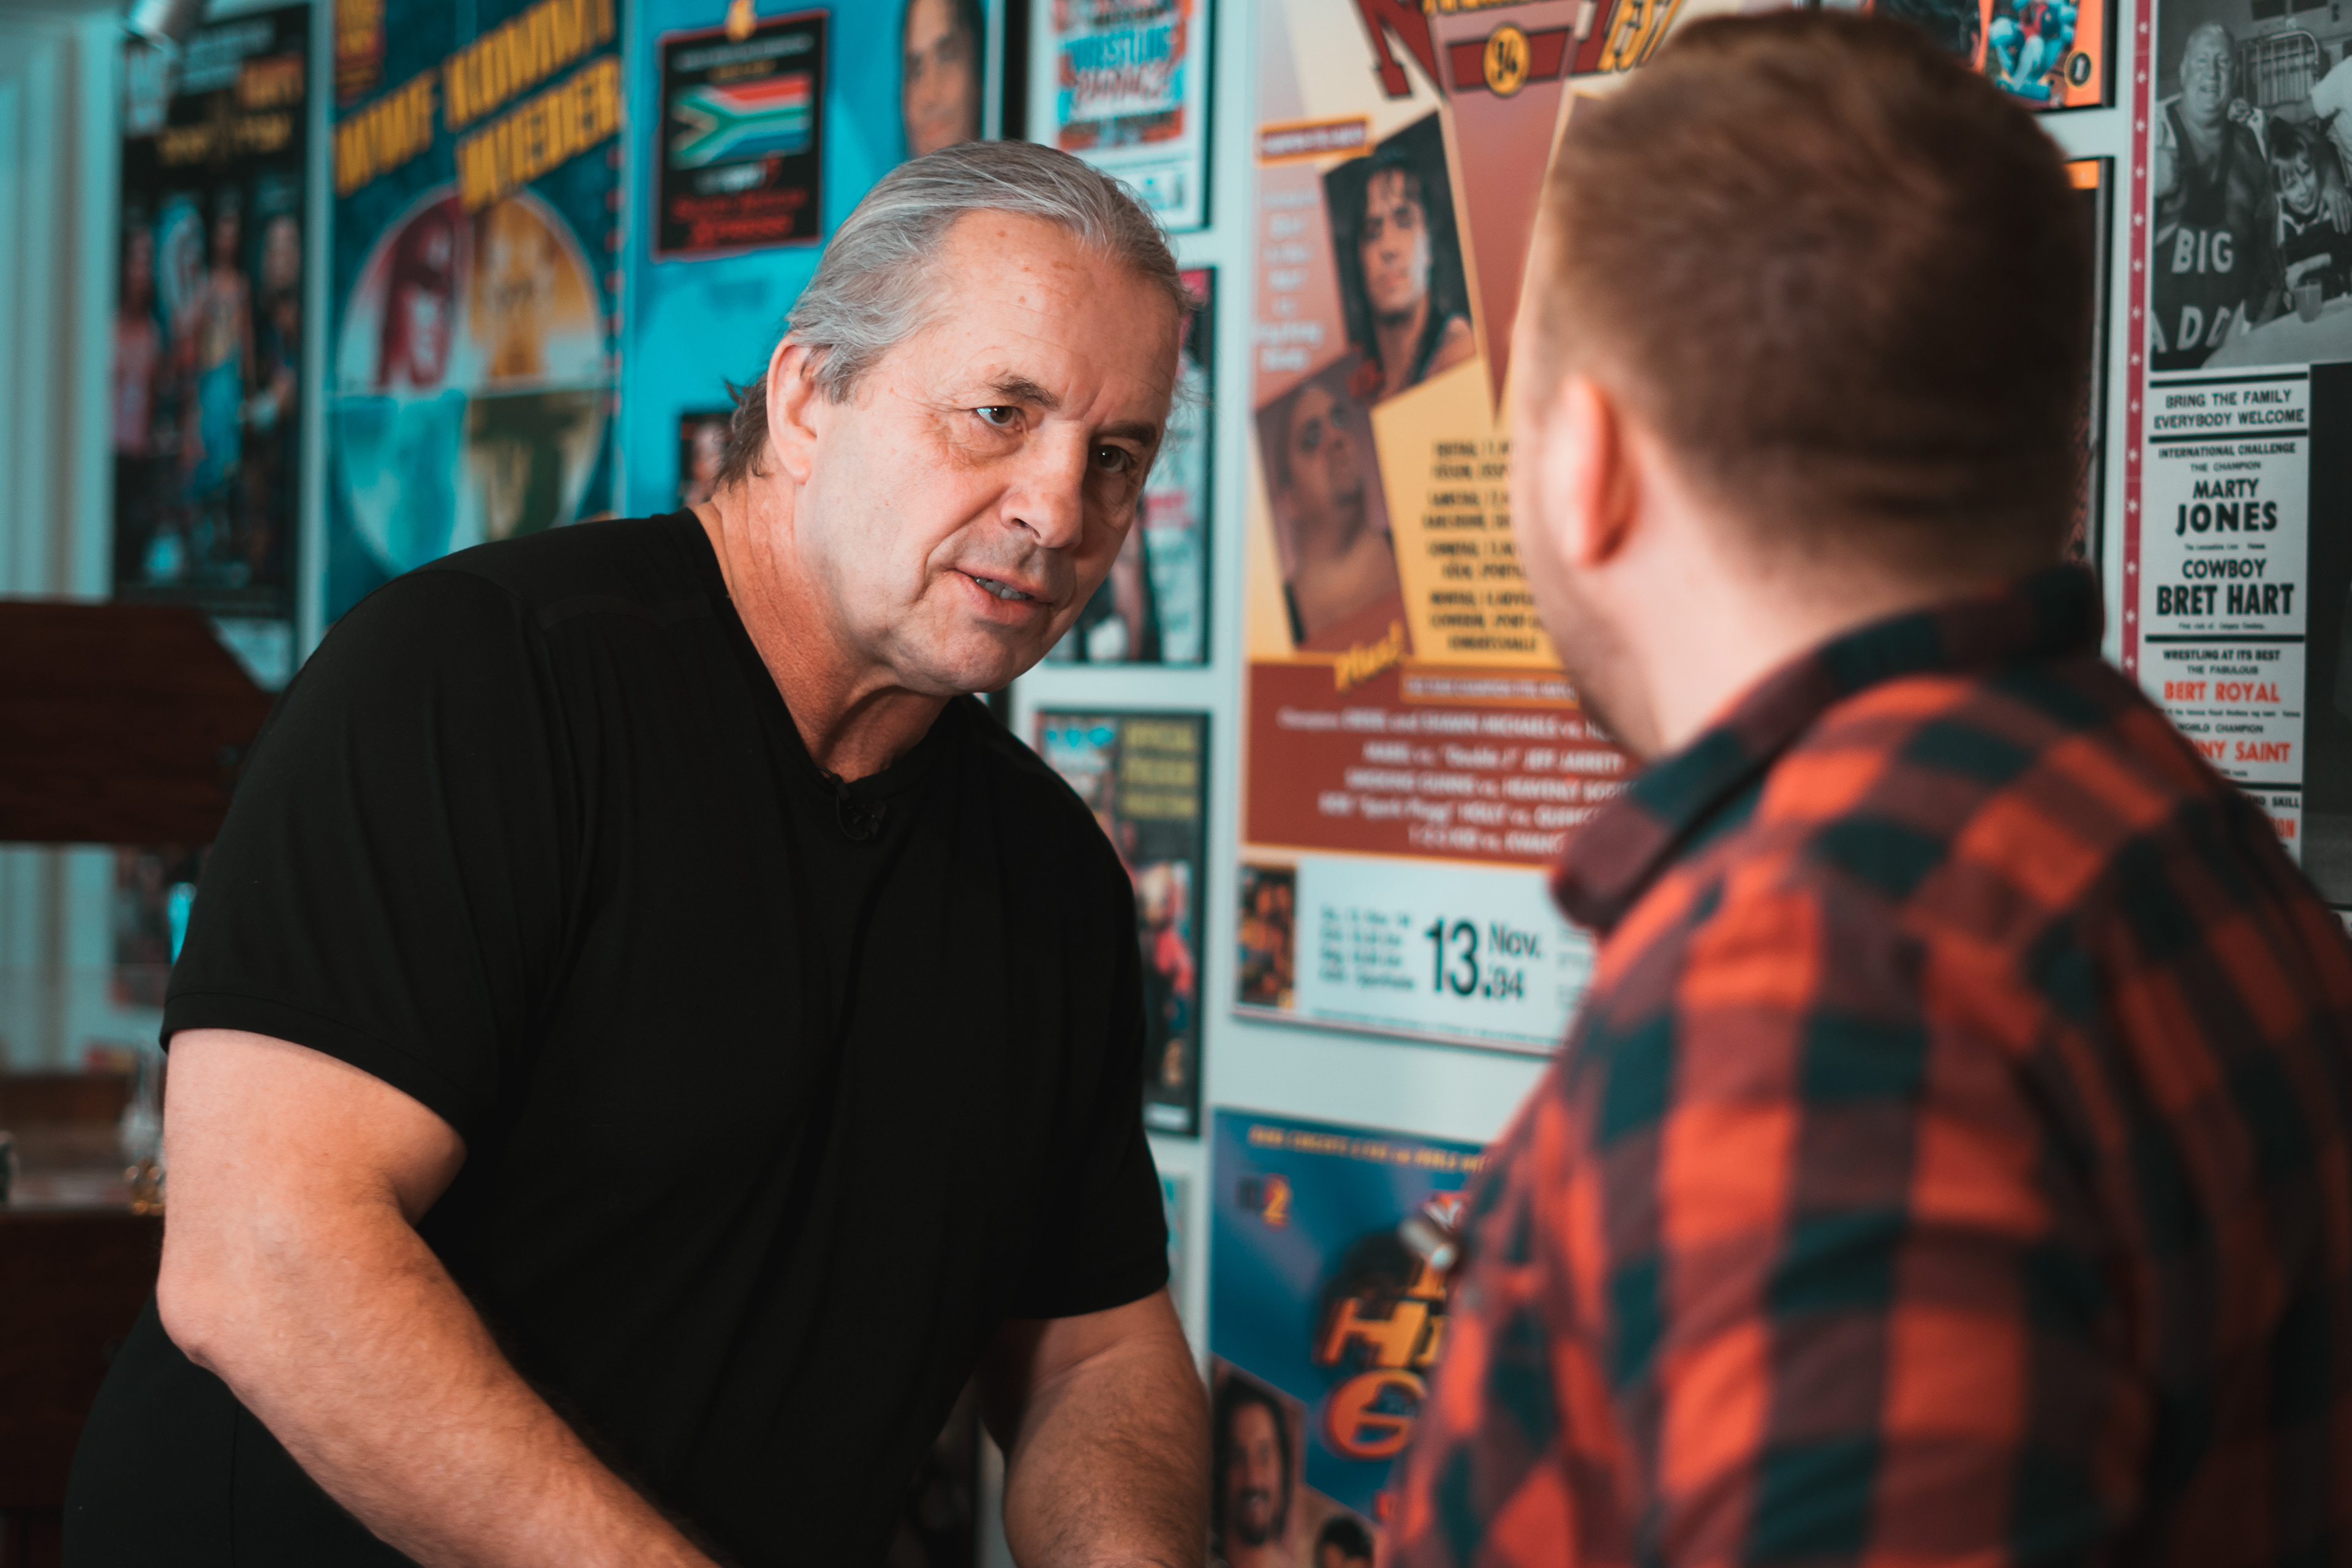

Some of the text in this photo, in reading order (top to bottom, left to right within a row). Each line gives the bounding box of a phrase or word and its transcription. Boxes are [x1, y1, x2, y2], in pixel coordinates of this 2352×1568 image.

[2171, 228, 2234, 274] BIG
[2166, 389, 2291, 409] BRING THE FAMILY
[2154, 409, 2305, 429] EVERYBODY WELCOME
[2158, 442, 2296, 458] INTERNATIONAL CHALLENGE
[2191, 461, 2261, 472] THE CHAMPION
[2193, 478, 2260, 499] MARTY
[2175, 501, 2277, 537] JONES
[2182, 559, 2266, 578] COWBOY
[2157, 584, 2294, 616] BRET HART
[2163, 649, 2280, 661] WRESTLING AT ITS BEST
[2188, 665, 2258, 674] THE FABULOUS
[2164, 680, 2280, 703] BERT ROYAL
[2215, 724, 2263, 733] CHAMPION
[1559, 749, 1625, 774] JARRETT
[2234, 740, 2291, 763] SAINT
[2272, 796, 2299, 808] SKILL
[1489, 924, 1541, 959] Nov.
